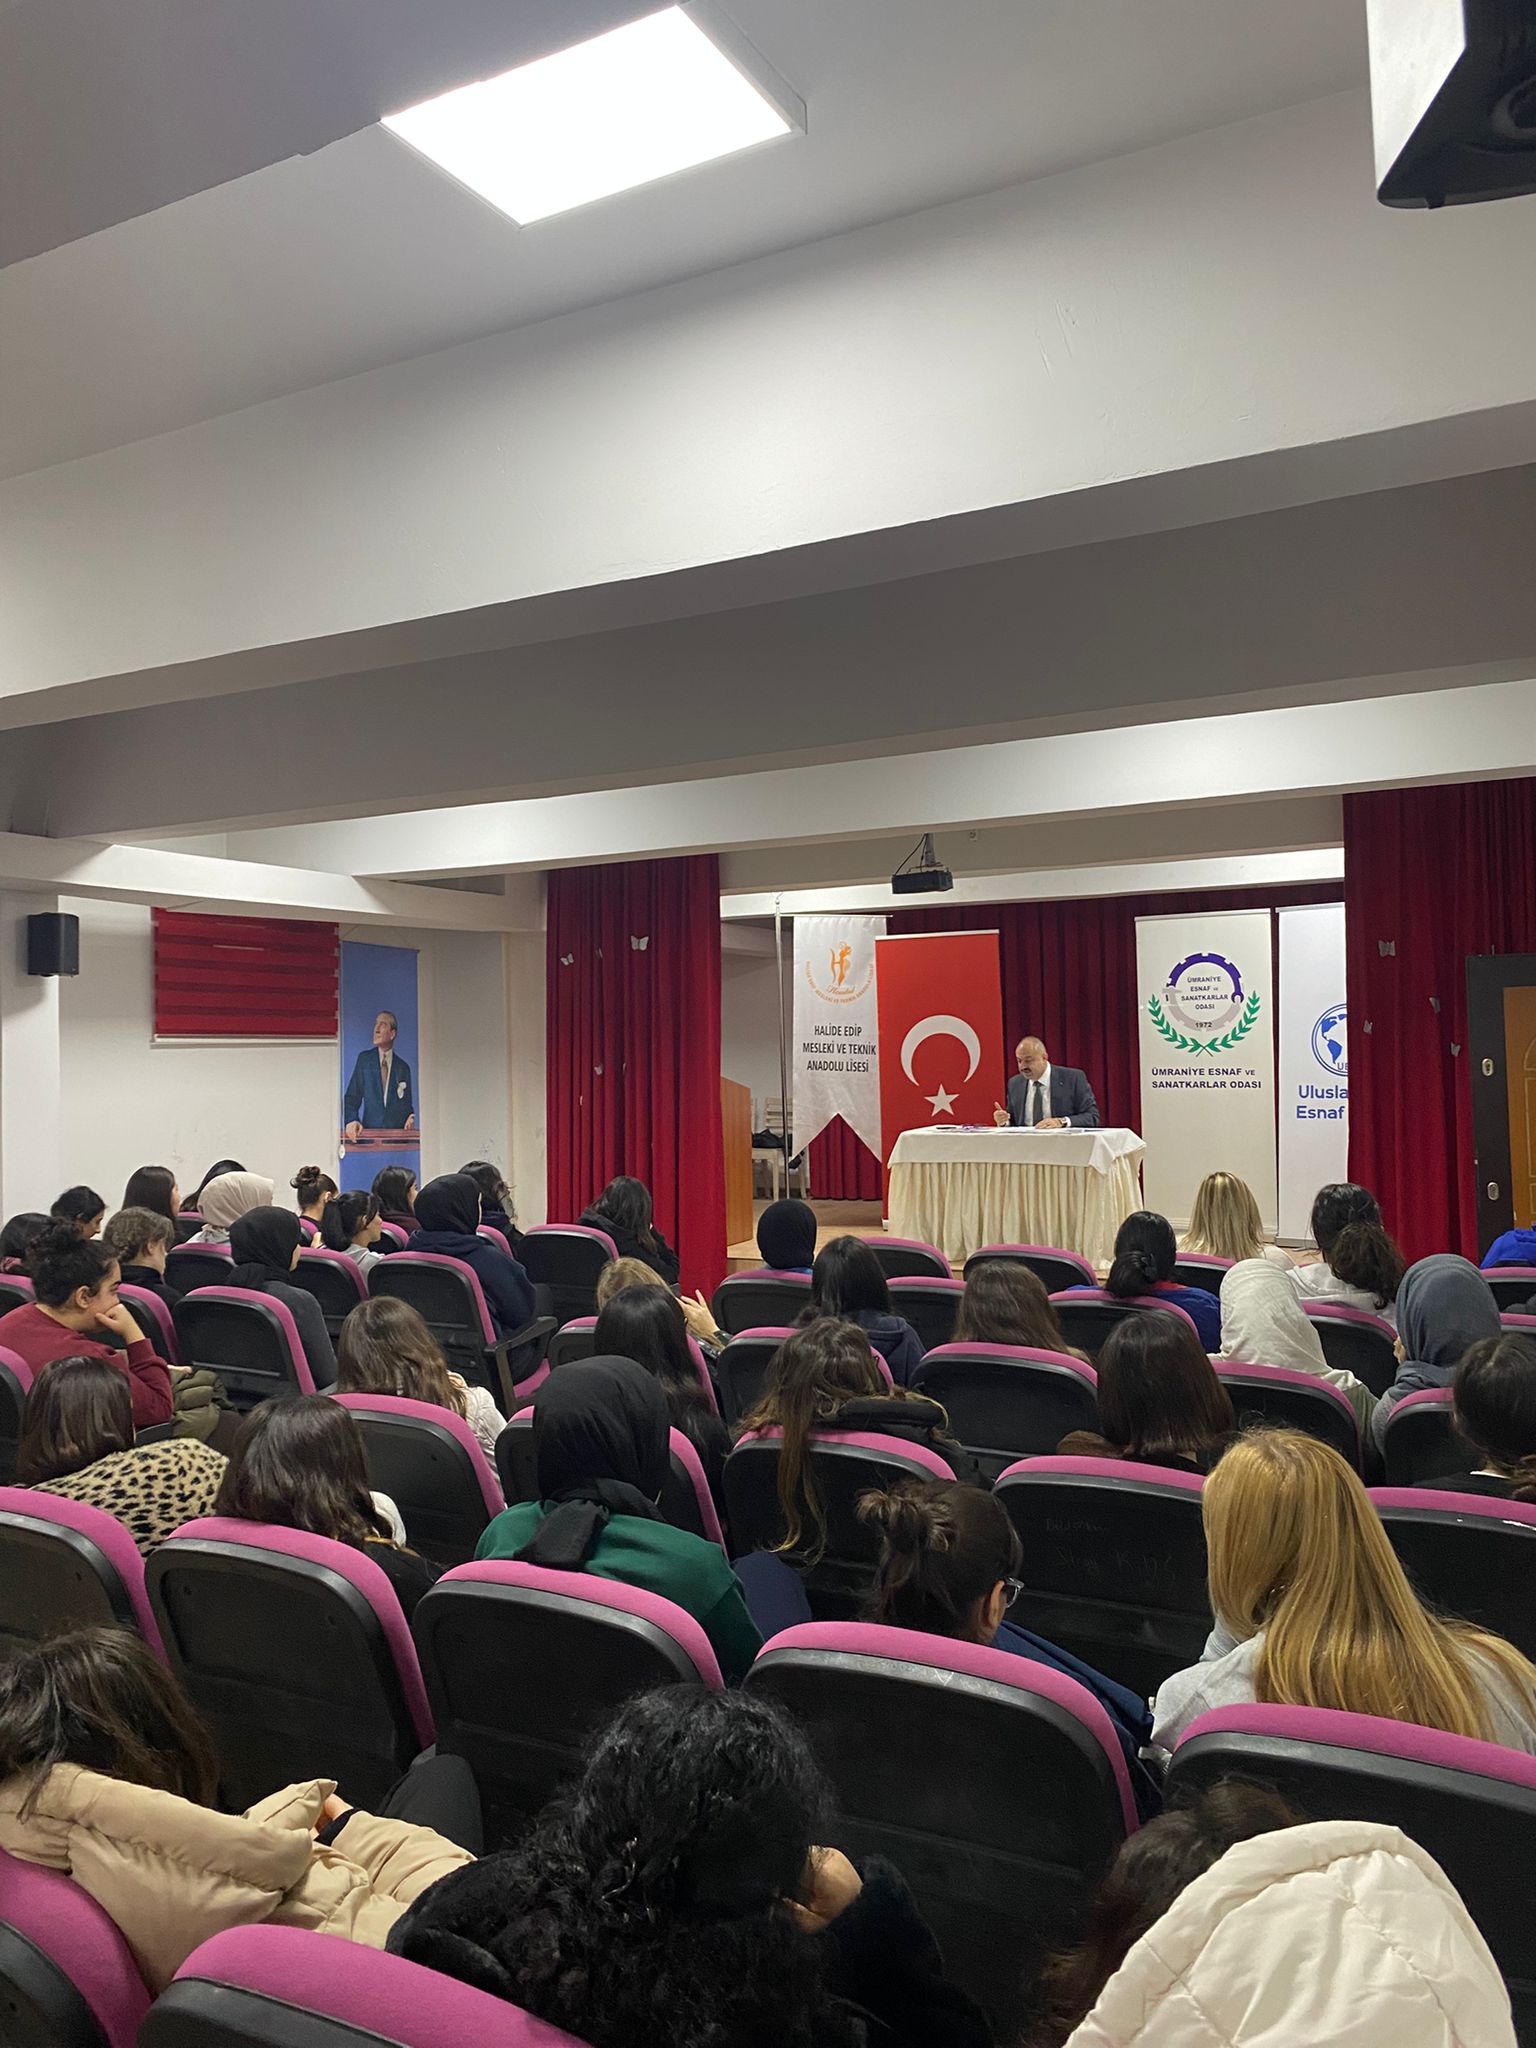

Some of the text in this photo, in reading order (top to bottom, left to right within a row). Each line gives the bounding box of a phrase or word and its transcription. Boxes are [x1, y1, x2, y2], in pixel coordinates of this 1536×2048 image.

[1187, 975, 1221, 983] ÜMRANİYE
[814, 1022, 862, 1037] HALİDE EDİP
[802, 1041, 877, 1056] MESLEKİ VE TEKNİK
[807, 1059, 869, 1073] ANADOLU LİSESİ
[1151, 1066, 1205, 1076] ÜMRANİYE
[1208, 1067, 1242, 1076] ESNAF
[1151, 1080, 1262, 1089] SANATKARLAR ODASI
[1296, 1105, 1345, 1119] Esnaf
